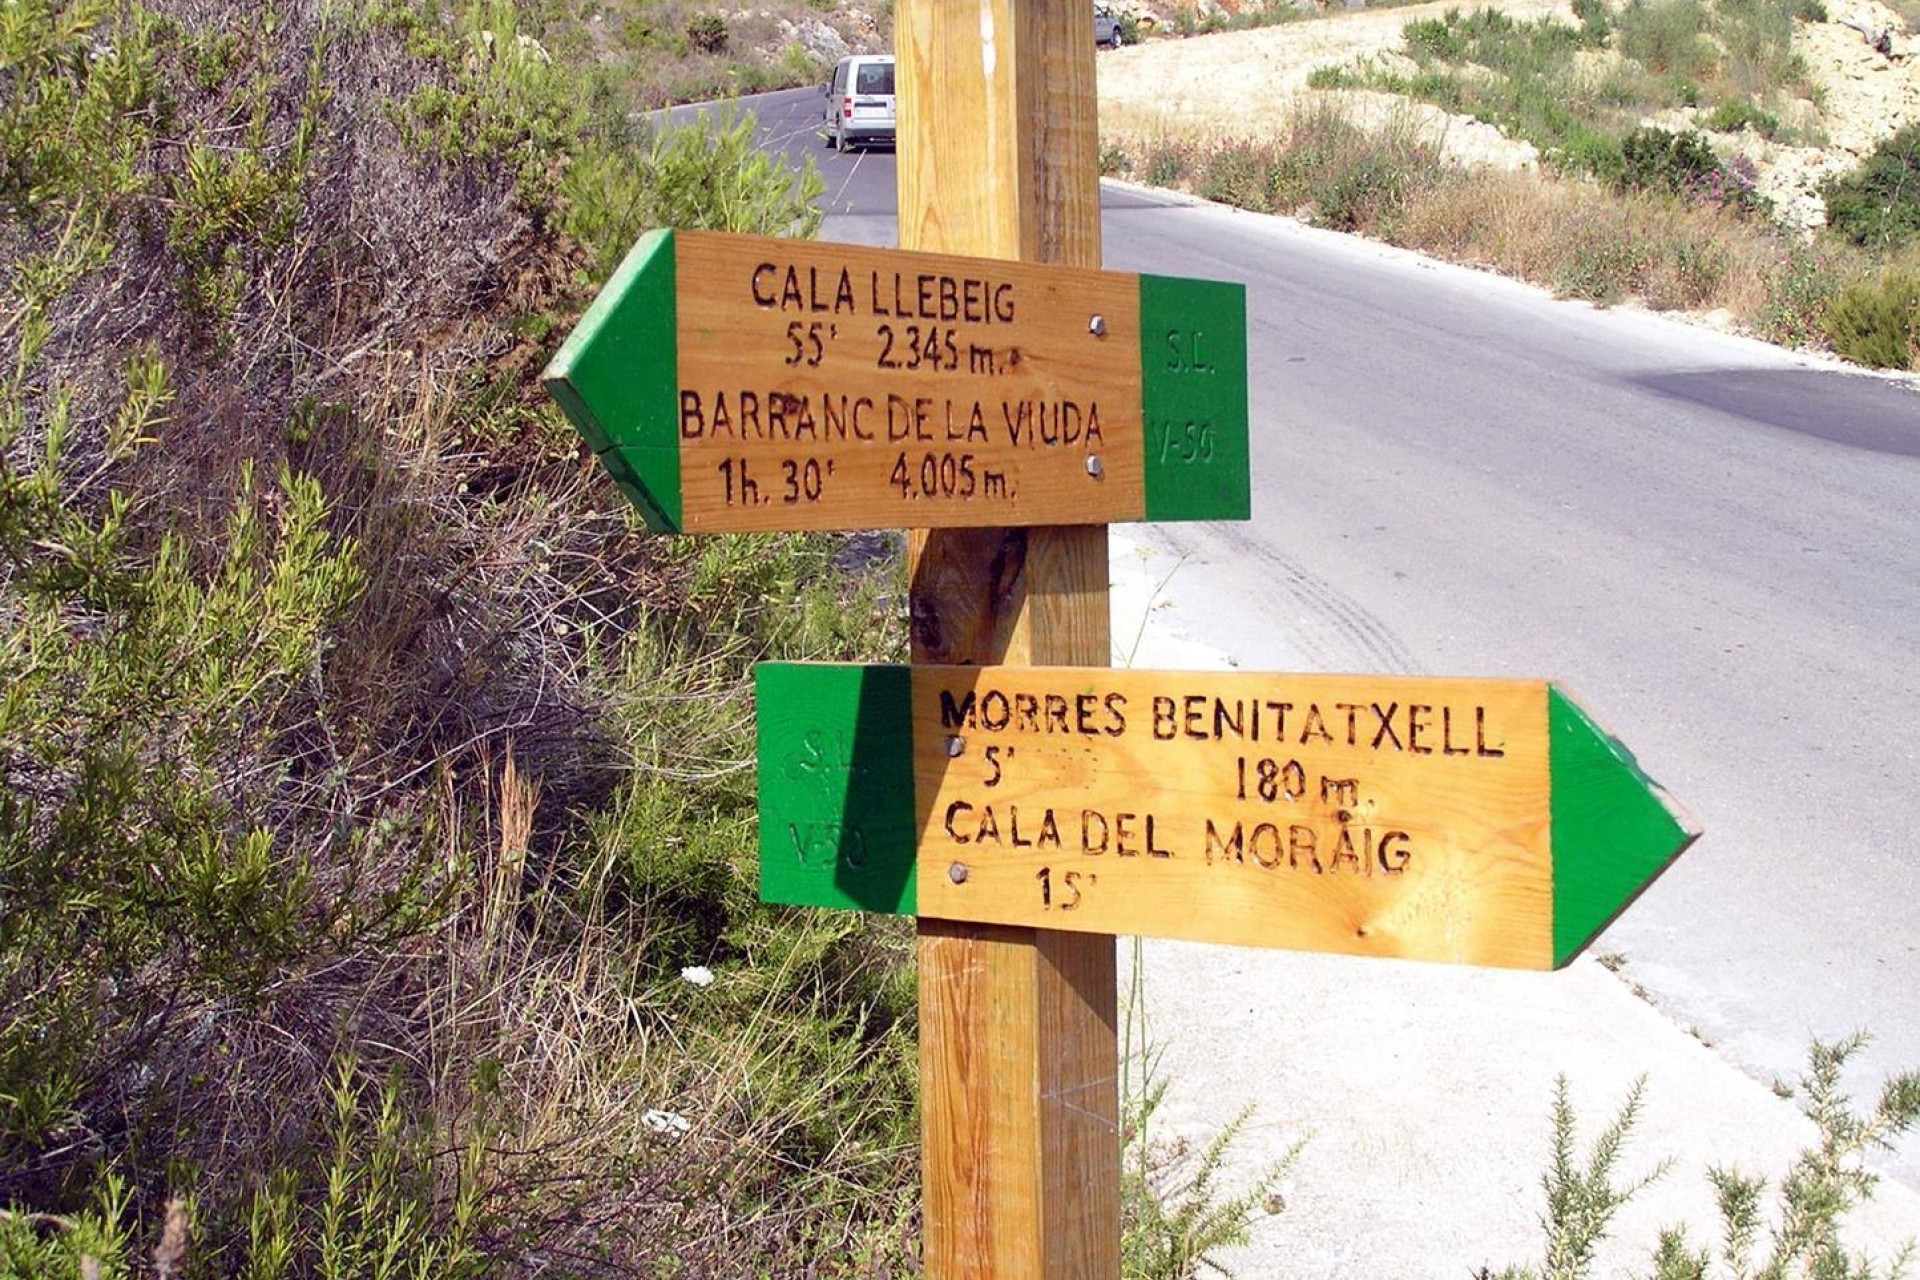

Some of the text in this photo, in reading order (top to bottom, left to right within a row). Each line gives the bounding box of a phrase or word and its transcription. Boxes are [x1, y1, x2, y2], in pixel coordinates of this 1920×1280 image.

[752, 263, 1014, 324] CALA LLEBEIG
[785, 321, 838, 368] 55'
[877, 325, 958, 371] 2.345
[1167, 330, 1215, 374] S.L.
[680, 389, 1104, 450] BARRANC DE LA VIUDA
[718, 457, 771, 505] 1h.
[782, 457, 836, 504] 30'
[890, 452, 976, 500] 4.005
[940, 689, 1505, 757] MORRES BENITATXELL
[984, 746, 1015, 788] 5'
[1237, 756, 1306, 802] 180
[944, 800, 1412, 876] CALA DEL MORAIG
[1036, 866, 1097, 911] 15'
